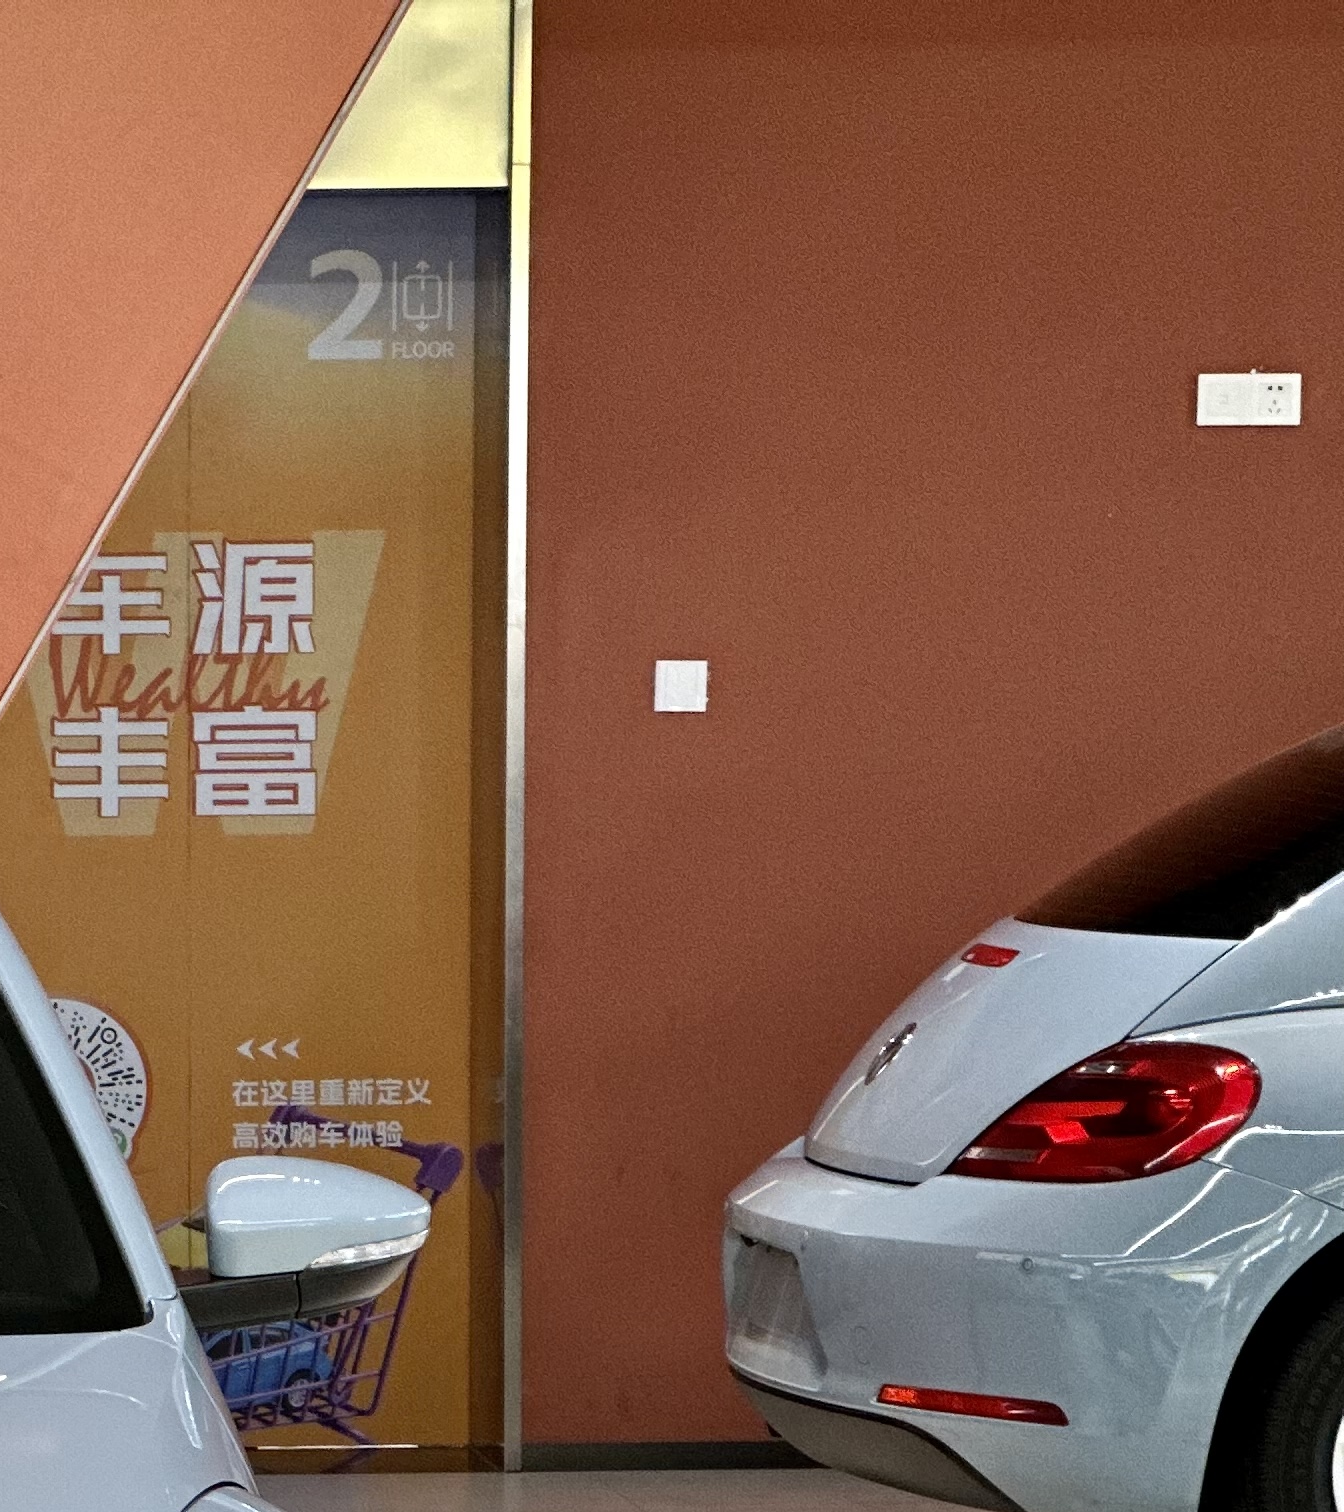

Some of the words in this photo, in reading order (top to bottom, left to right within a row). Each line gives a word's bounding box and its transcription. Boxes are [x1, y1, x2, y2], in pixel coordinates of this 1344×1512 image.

[307, 248, 384, 361] 2
[391, 339, 456, 360] FLOOR
[51, 537, 317, 655] 车源
[51, 705, 318, 818] 丰富
[232, 1077, 432, 1107] 在这里重新定义
[232, 1120, 404, 1149] 高效购车体验
